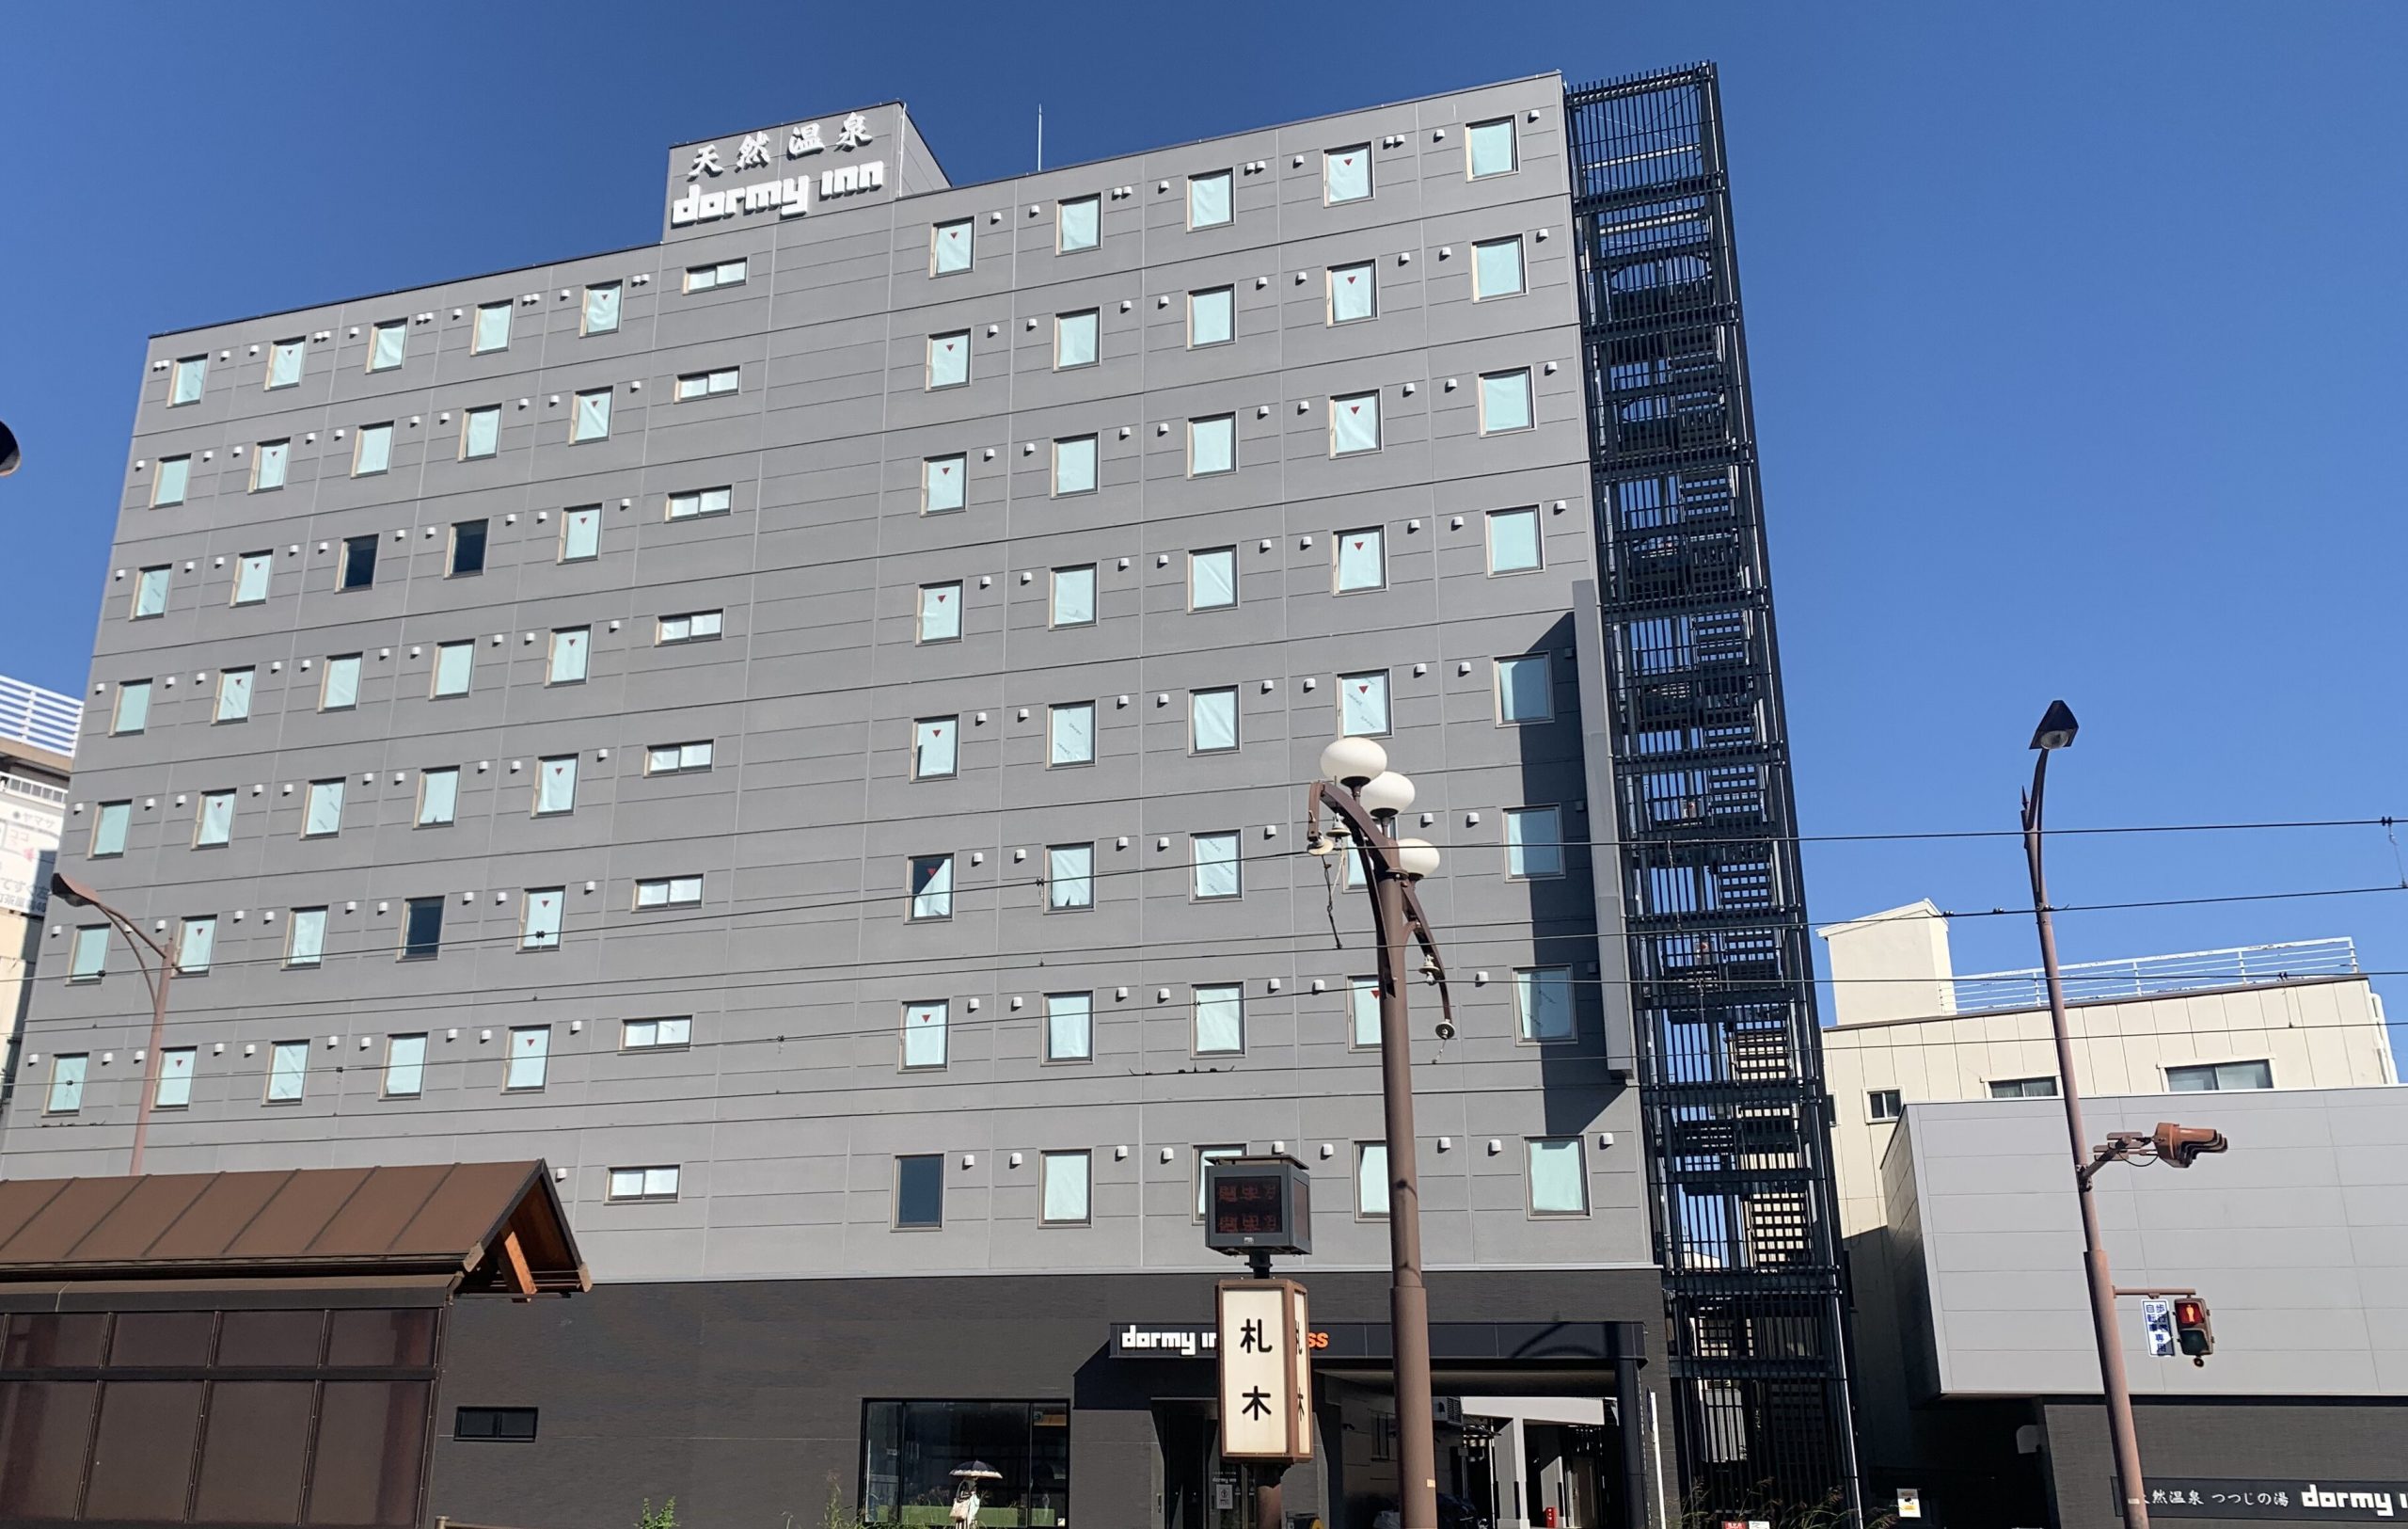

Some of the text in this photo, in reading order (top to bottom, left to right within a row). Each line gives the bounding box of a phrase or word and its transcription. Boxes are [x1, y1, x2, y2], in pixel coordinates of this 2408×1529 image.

[689, 112, 873, 176] 天然温泉
[673, 160, 884, 224] dormy inn
[1122, 1325, 1217, 1355] dormy in
[1240, 1317, 1273, 1422] 札木
[2211, 1491, 2289, 1506] つつじの湯
[2301, 1484, 2394, 1516] dormy
